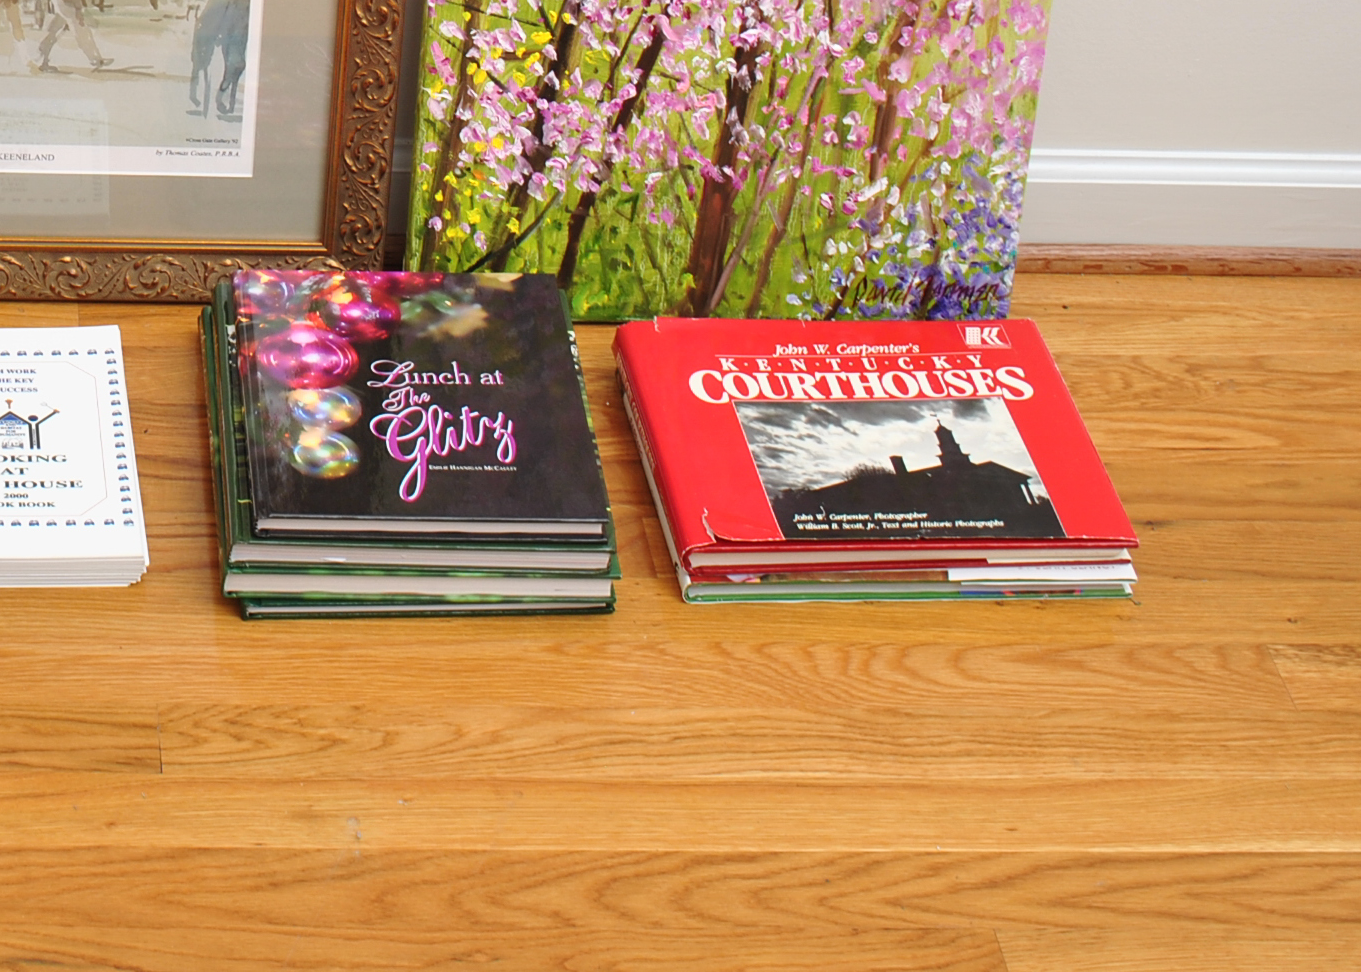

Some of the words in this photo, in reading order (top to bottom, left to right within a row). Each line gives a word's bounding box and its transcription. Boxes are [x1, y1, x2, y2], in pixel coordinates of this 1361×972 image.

[155, 149, 163, 157] by
[773, 344, 808, 358] John
[813, 344, 831, 355] W.
[836, 342, 920, 359] Carpenter's
[366, 359, 472, 388] Lunch
[480, 369, 504, 386] at
[688, 366, 1034, 404] COURTHOUSES
[381, 385, 431, 412] The
[369, 404, 518, 503] Glitz
[0, 467, 29, 476] AT
[4, 480, 83, 489] HOUSE
[793, 513, 814, 522] John
[829, 512, 872, 522] Carpenter,
[874, 511, 928, 521] Photographer
[796, 522, 829, 530] William
[901, 521, 919, 529] and
[920, 520, 953, 528] Historic
[954, 519, 1005, 529] Photographs
